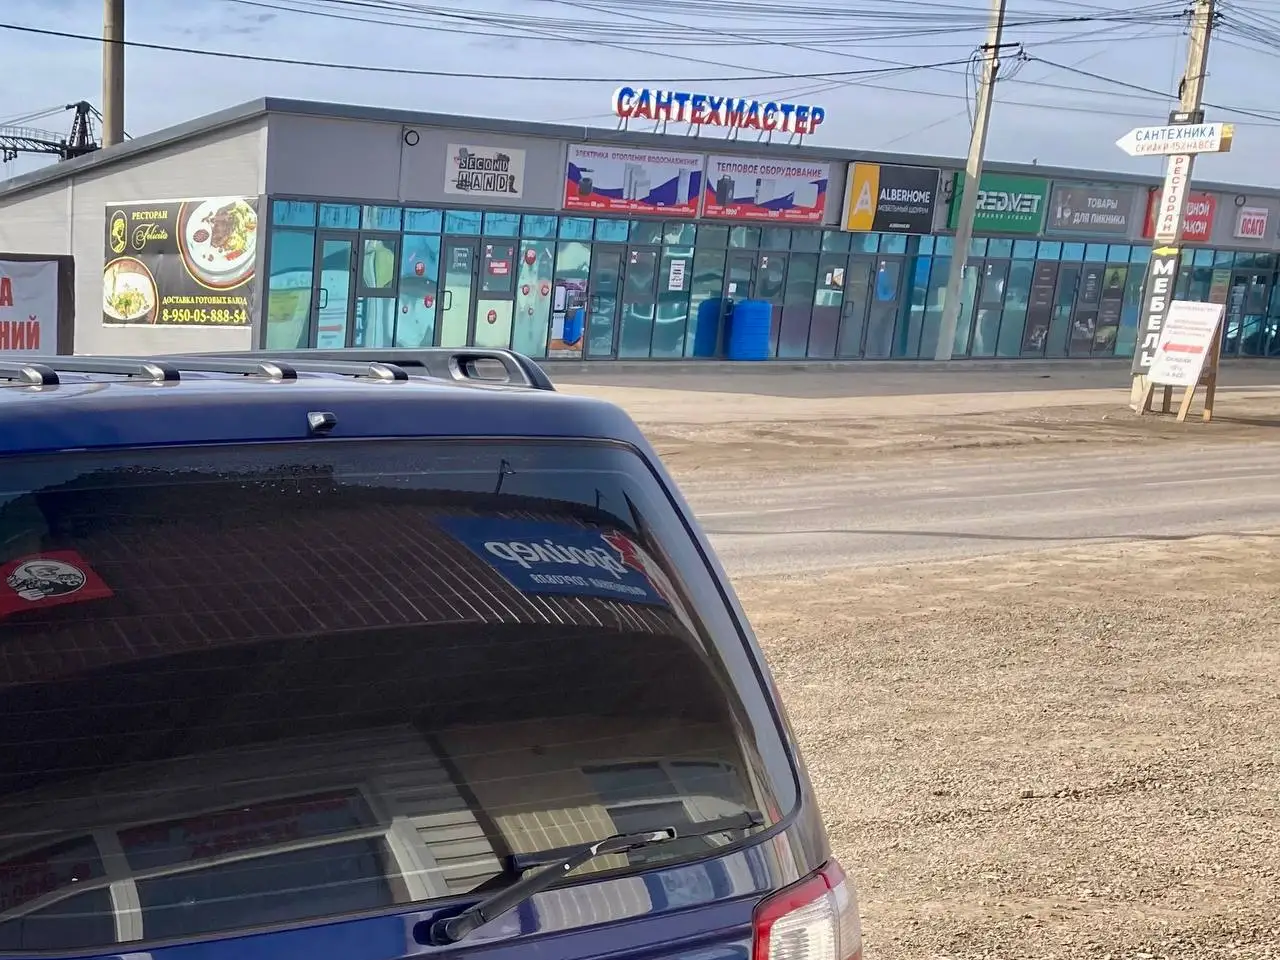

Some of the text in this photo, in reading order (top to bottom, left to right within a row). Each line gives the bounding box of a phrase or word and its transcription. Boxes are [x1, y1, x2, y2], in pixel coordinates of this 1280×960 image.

[614, 86, 825, 134] САНТЕХМАСТЕР
[1136, 127, 1215, 140] САНТЕХНИКА
[1136, 141, 1169, 152] СКИДКИ
[459, 158, 509, 171] SECOND
[717, 162, 822, 178] ТЕПЛОВОЕ ОБОРУДОВАНИЕ
[459, 171, 508, 192] HAND
[880, 188, 930, 203] ALBERHOME
[1163, 157, 1184, 231] РЕСТОРАН
[1087, 197, 1119, 208] ТОВАРЫ
[132, 211, 168, 220] РЕСТОРАН
[1073, 214, 1126, 225] ДЛЯ ПИКНИКА
[1241, 218, 1264, 236] ОСАГО
[162, 297, 247, 305] ДОСТАВКА ГОТОВЫХ БЛЮД
[162, 309, 246, 323] 8-950-05-888-54
[1140, 259, 1174, 367] МЕБЕЛЬ
